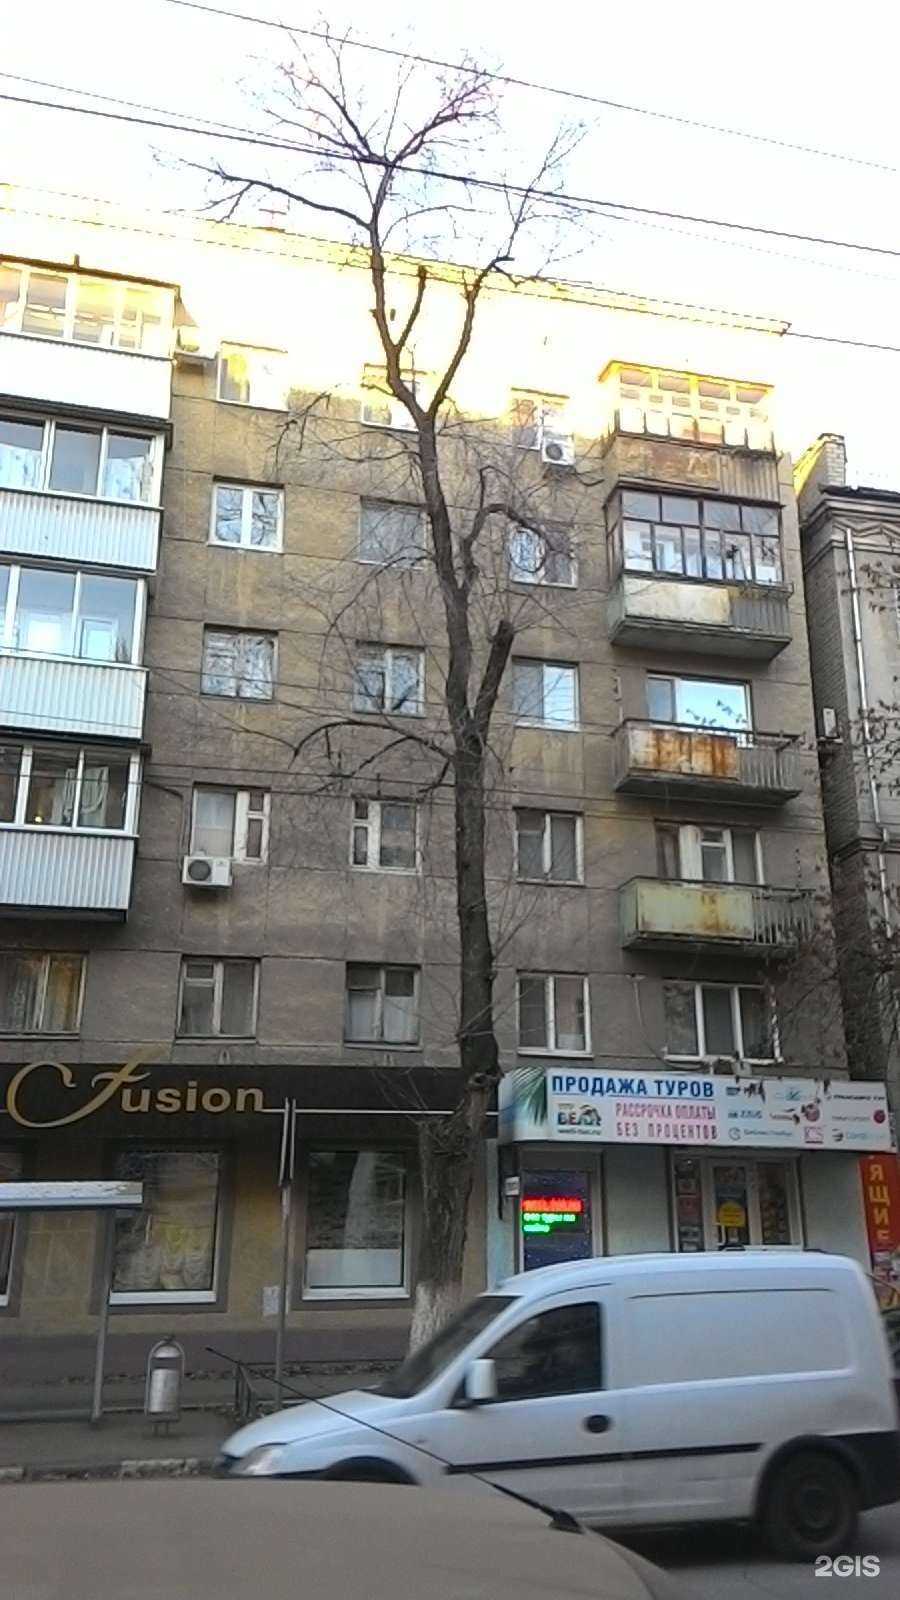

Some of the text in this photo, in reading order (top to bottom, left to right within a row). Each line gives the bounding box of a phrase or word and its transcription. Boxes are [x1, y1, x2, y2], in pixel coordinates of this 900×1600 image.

[552, 1075, 648, 1097] ПРОДАЖА
[655, 1080, 715, 1098] ТУРОВ
[616, 1102, 673, 1119] РАССРОЧКА
[675, 1104, 716, 1120] ОПЛАТЫ
[616, 1122, 639, 1136] БЕЗ
[648, 1122, 718, 1140] ПРОЦЕНТОВ
